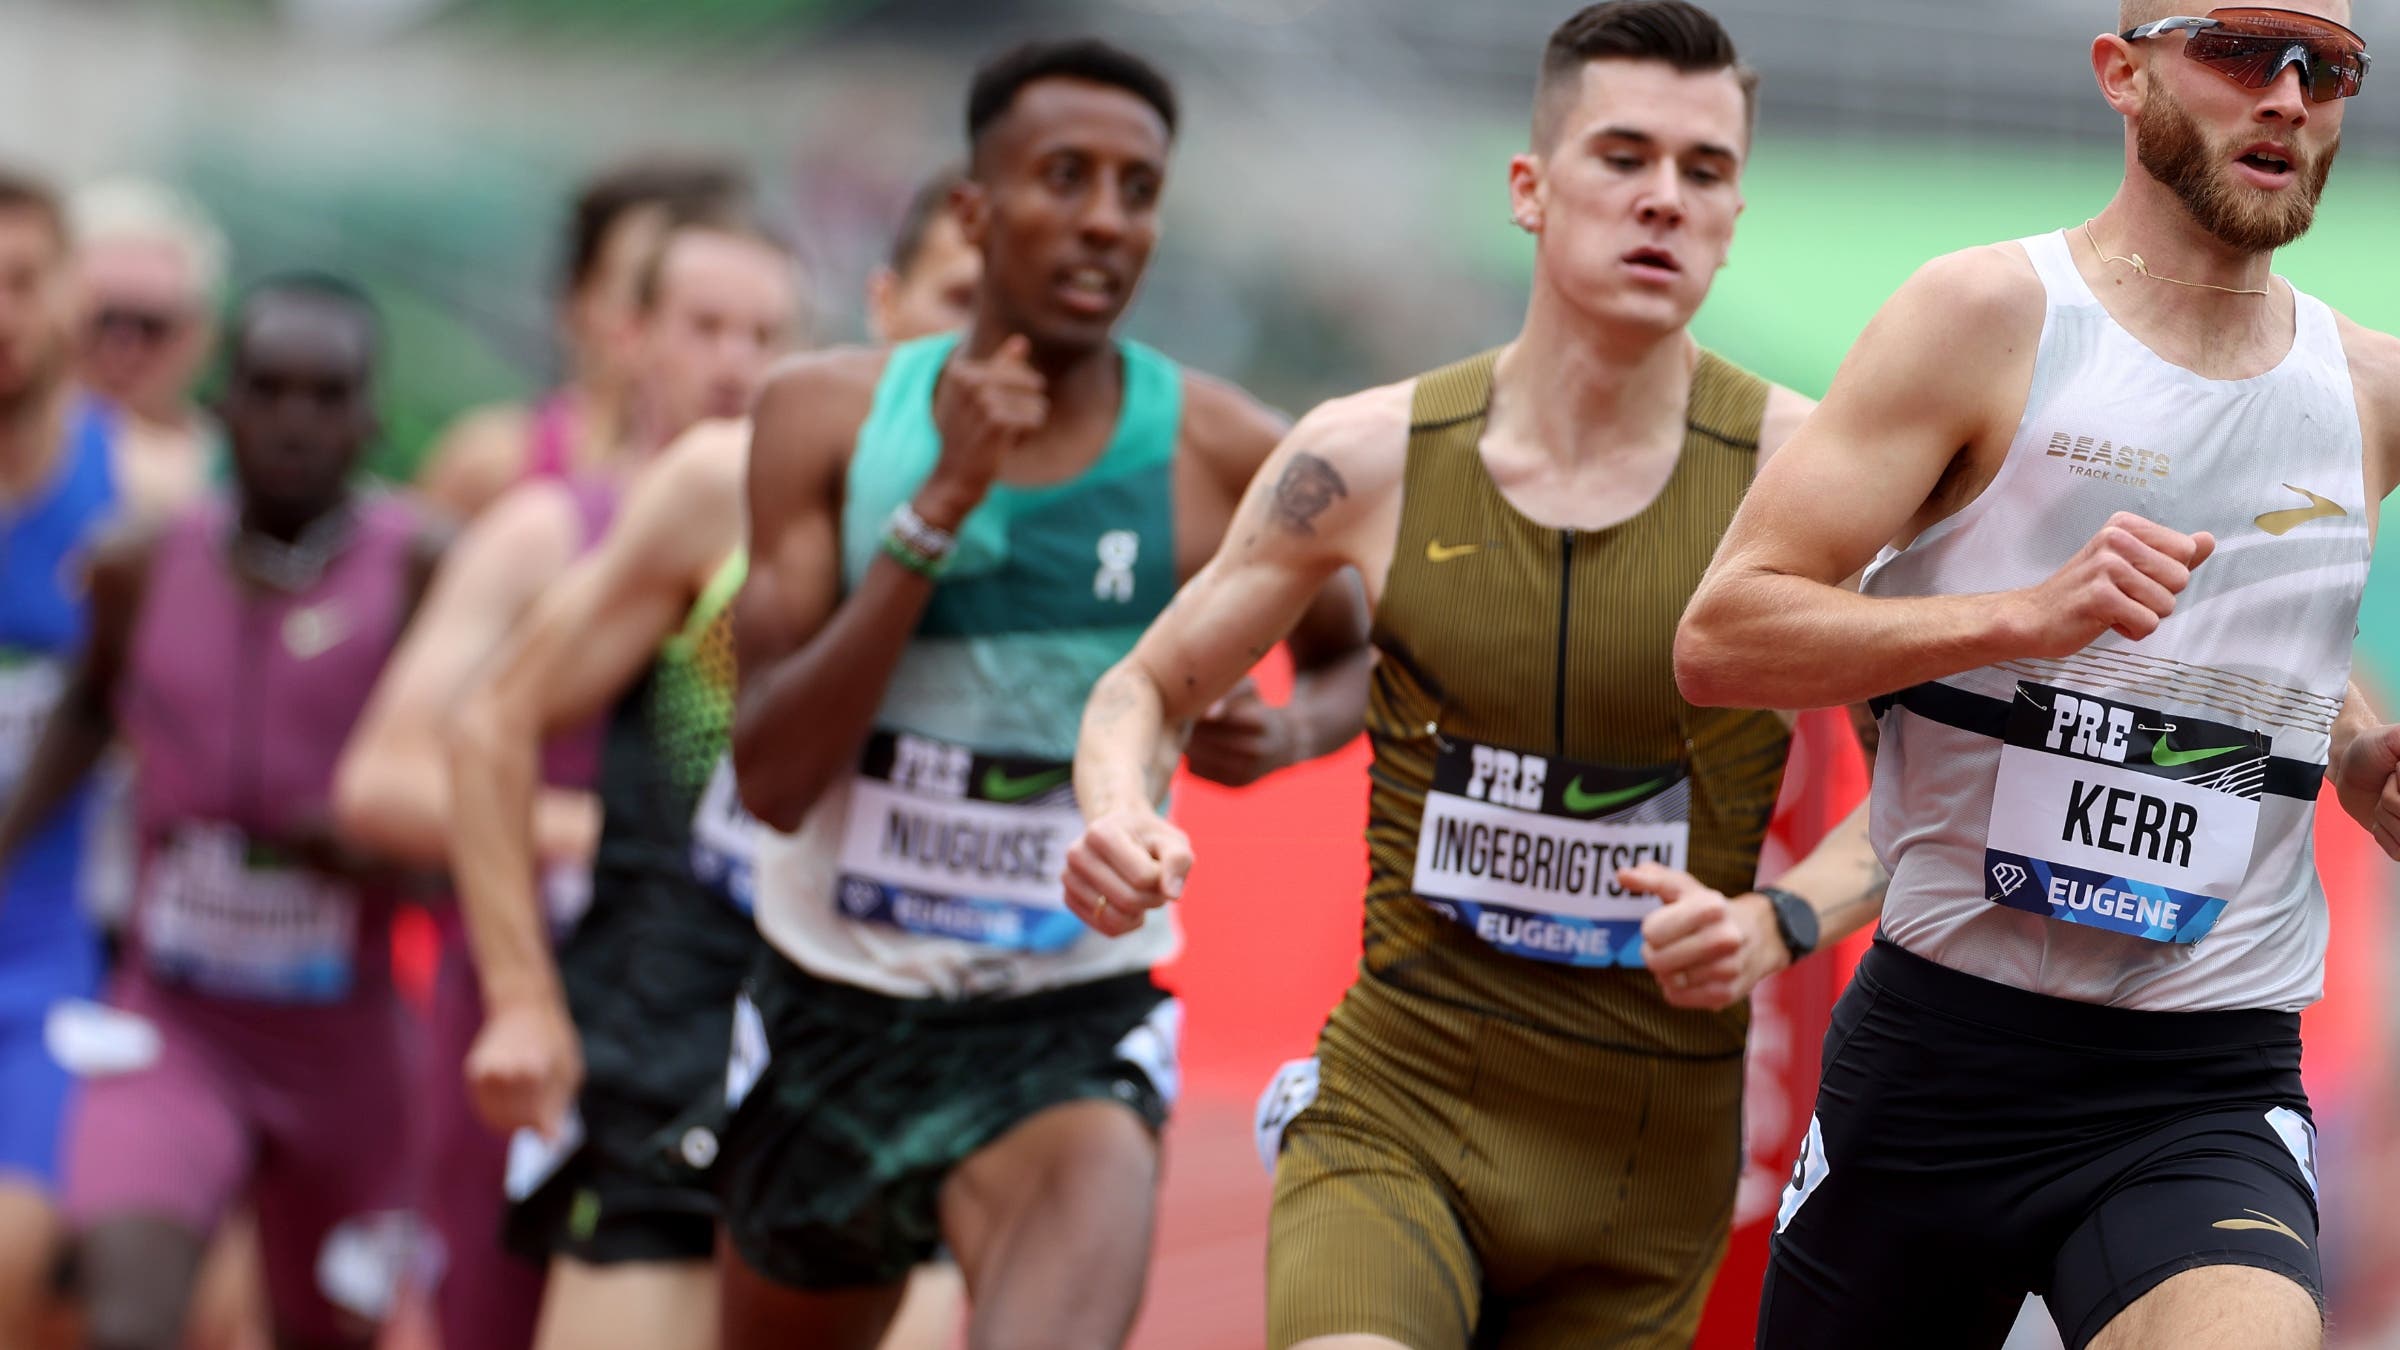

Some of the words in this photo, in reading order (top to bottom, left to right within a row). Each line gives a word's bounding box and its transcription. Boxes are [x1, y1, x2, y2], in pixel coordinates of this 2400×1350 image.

[2046, 431, 2170, 477] BEASTS
[2068, 464, 2110, 481] TRACK
[2114, 473, 2148, 488] CLUB
[2045, 693, 2134, 763] PRE
[890, 735, 974, 799] PRE
[1466, 744, 1549, 812] PRE
[882, 806, 1057, 884] NUGUSE
[2061, 779, 2199, 868] KERR
[1476, 911, 1612, 957] EUGENE
[2047, 876, 2182, 931] EUGENE
